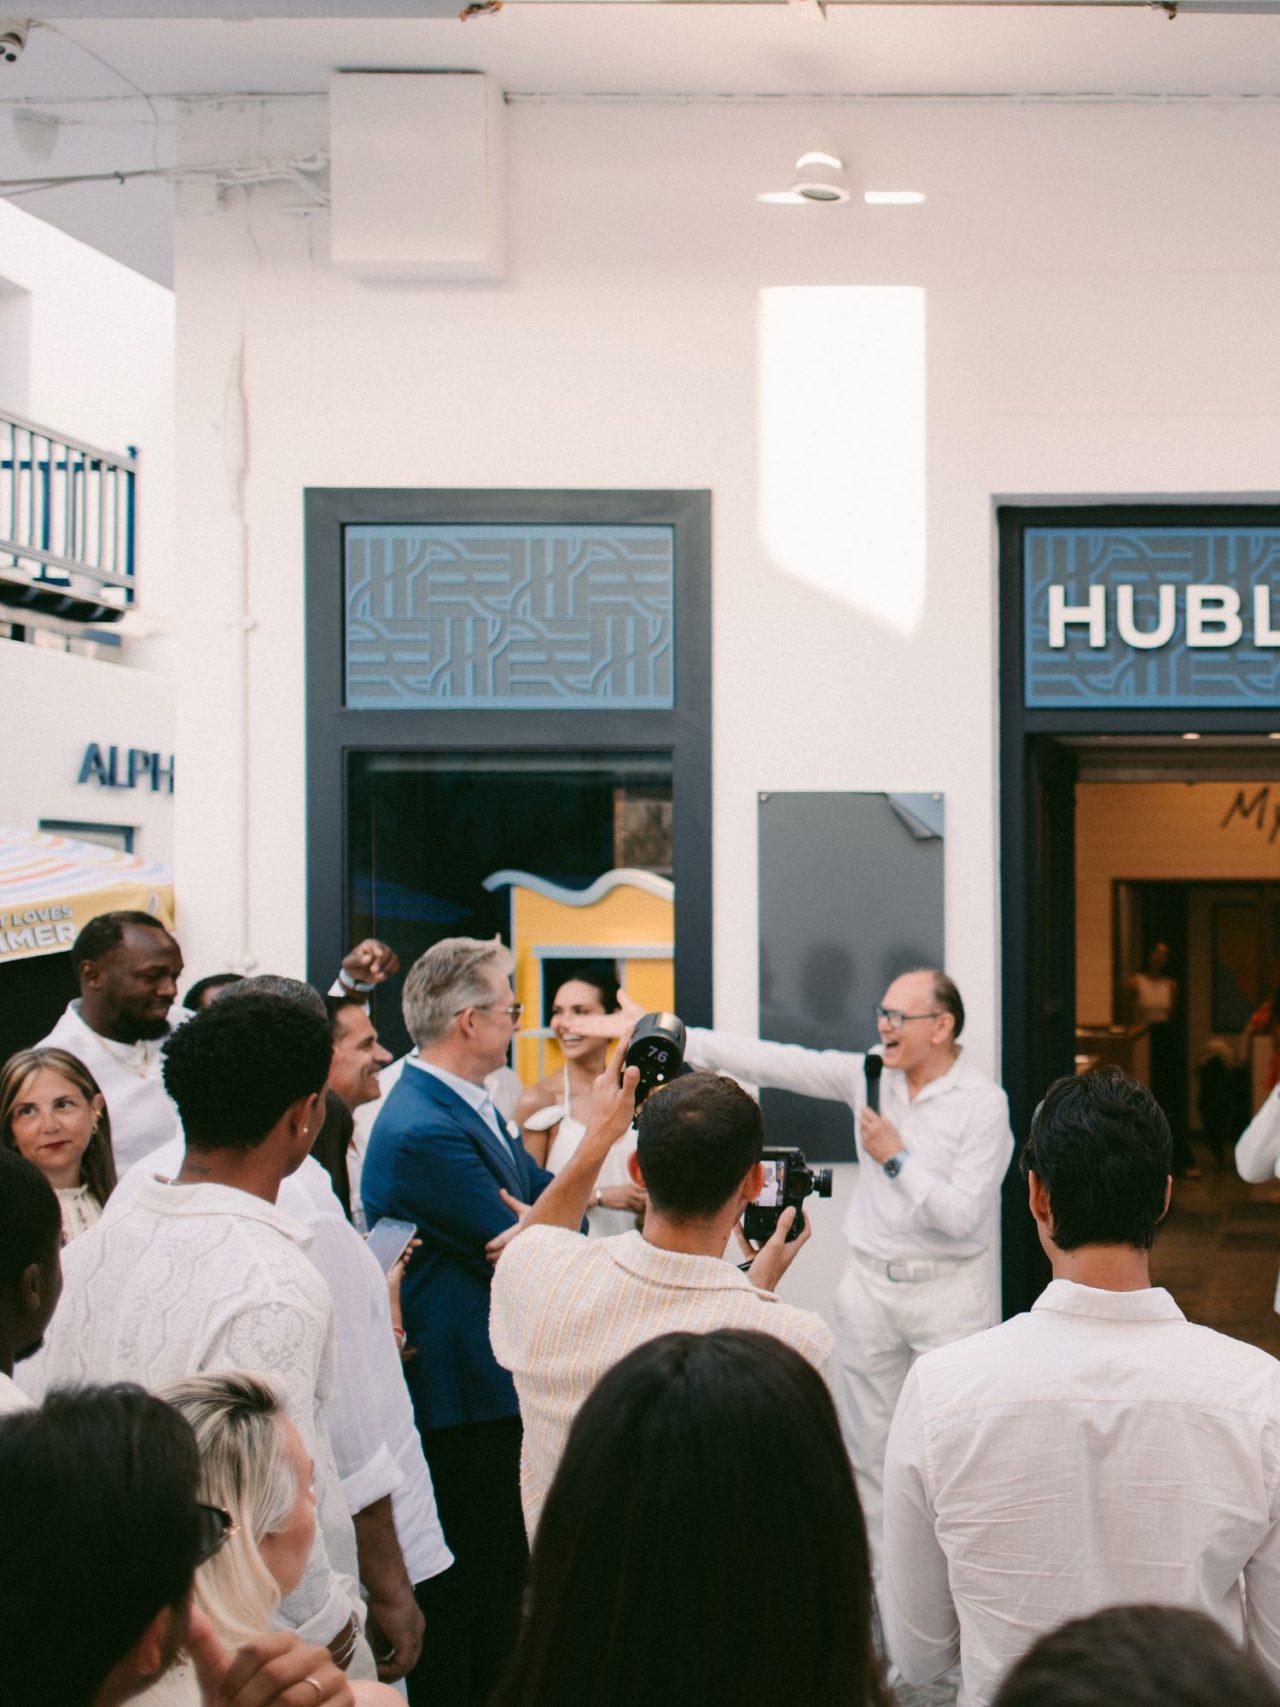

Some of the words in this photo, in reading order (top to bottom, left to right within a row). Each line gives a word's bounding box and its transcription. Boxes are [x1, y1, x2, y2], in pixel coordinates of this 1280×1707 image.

[77, 742, 174, 793] ALPH
[11, 905, 73, 927] LOVES
[647, 1045, 669, 1063] 7.6
